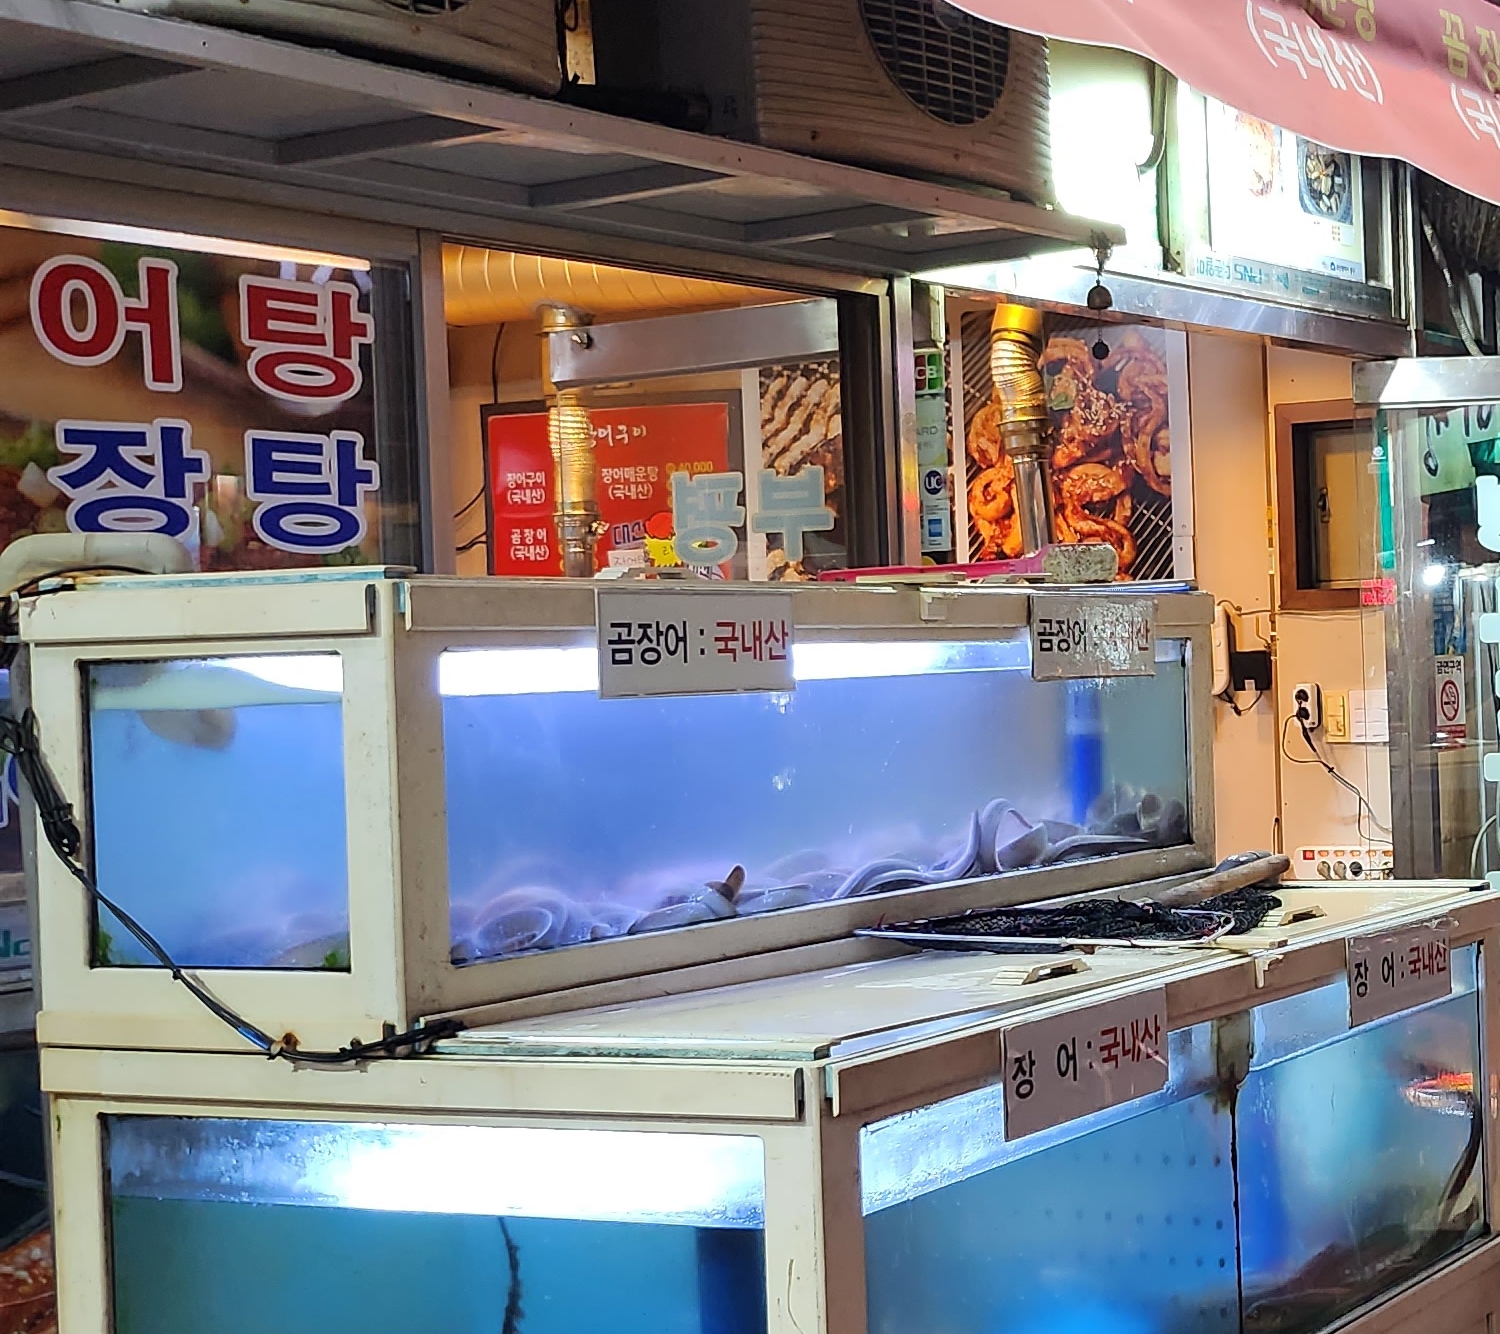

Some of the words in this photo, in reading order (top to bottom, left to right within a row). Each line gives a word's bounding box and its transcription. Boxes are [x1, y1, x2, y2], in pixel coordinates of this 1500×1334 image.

[1246, 0, 1384, 105] (국내산)
[506, 471, 547, 489] 장어구이
[608, 483, 654, 500] (국내산)
[507, 488, 547, 505] (국내산)
[510, 545, 550, 561] (국내산)
[607, 620, 690, 666] 곰장어
[713, 619, 789, 662] 국내산
[1037, 617, 1087, 653] 곰장어
[1436, 658, 1463, 675] 금연구역
[1408, 940, 1448, 978] 국내산
[1099, 1015, 1162, 1070] 국내산
